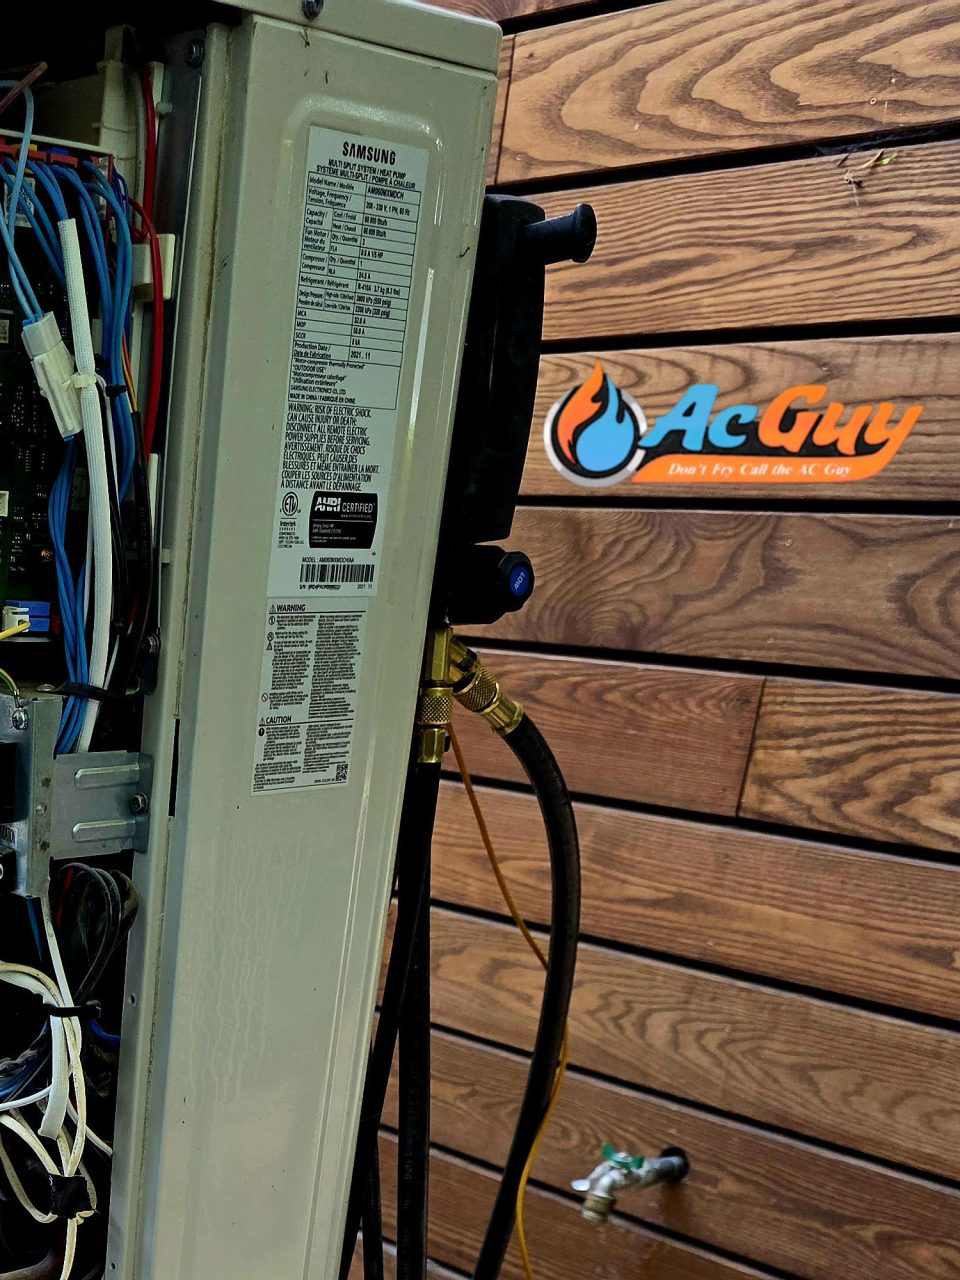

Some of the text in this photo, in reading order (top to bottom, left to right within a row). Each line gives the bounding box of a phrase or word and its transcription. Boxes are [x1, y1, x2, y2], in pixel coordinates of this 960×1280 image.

[342, 141, 396, 165] SAMSUNG
[328, 159, 407, 180] MULTI SPLIT SYSTEM HEAT PUMP
[340, 169, 368, 181] MULTI-SPLIT
[372, 175, 388, 185] POMPE
[393, 179, 415, 190] CHALEUR
[307, 208, 325, 218] Capacity
[295, 342, 318, 350] Production
[289, 392, 300, 400] MADE
[314, 405, 326, 414] RISK
[326, 406, 333, 414] OF
[333, 406, 355, 416] ELECTRIC
[287, 412, 298, 422] CAN
[298, 413, 314, 423] CAUSE
[332, 415, 340, 425] OR
[286, 422, 368, 436] DISCONNECT ALL REMOTE ELECTRIC
[285, 432, 304, 441] POWER
[304, 433, 327, 443] SUPPLIES
[327, 434, 345, 444] BEFORE
[343, 445, 350, 454] DE
[350, 446, 366, 454] CHOCS
[317, 453, 329, 462] PEUT
[283, 460, 310, 470] BLESSURES
[282, 470, 301, 479] COUPER
[301, 471, 311, 480] LES
[311, 471, 333, 481] SOURCES
[285, 480, 309, 489] DISTANCE
[309, 481, 325, 490] AVANT
[341, 502, 374, 514] CERTIFIED
[514, 571, 526, 590] LOW
[276, 603, 306, 612] WARNING
[265, 715, 292, 724] CAUTION
